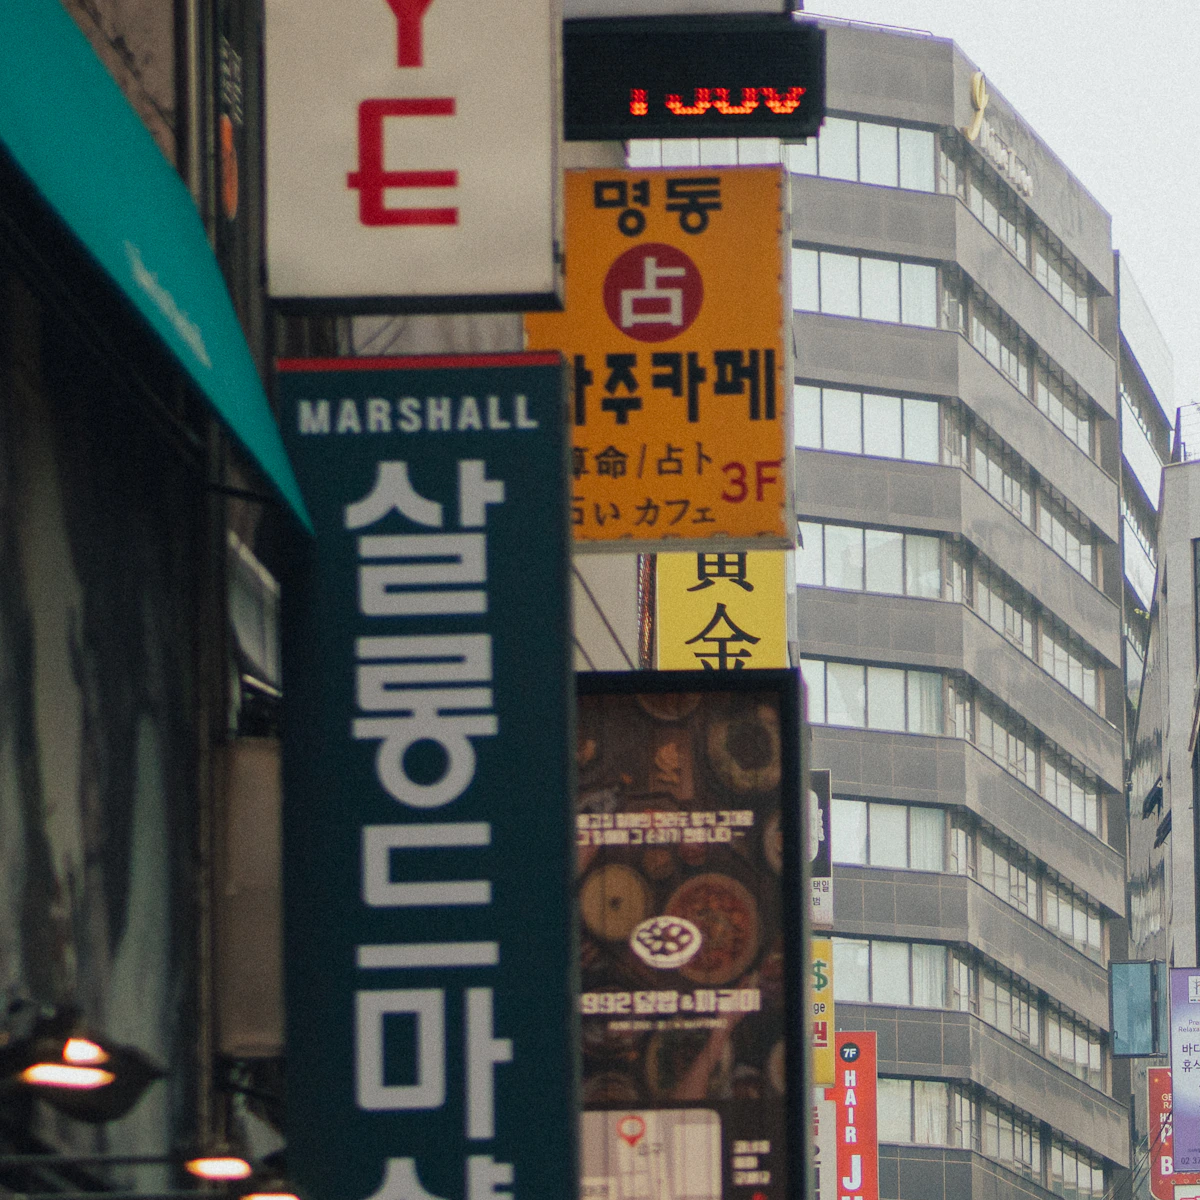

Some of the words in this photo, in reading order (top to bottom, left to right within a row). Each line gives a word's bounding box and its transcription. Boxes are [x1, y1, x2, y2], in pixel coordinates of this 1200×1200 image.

[594, 177, 722, 236] 명동
[619, 257, 686, 327] 占
[298, 395, 539, 434] MARSHALL
[721, 460, 782, 503] 3F
[843, 1047, 856, 1058] 7F
[844, 1070, 857, 1143] HAIR
[1180, 1156, 1191, 1165] 02
